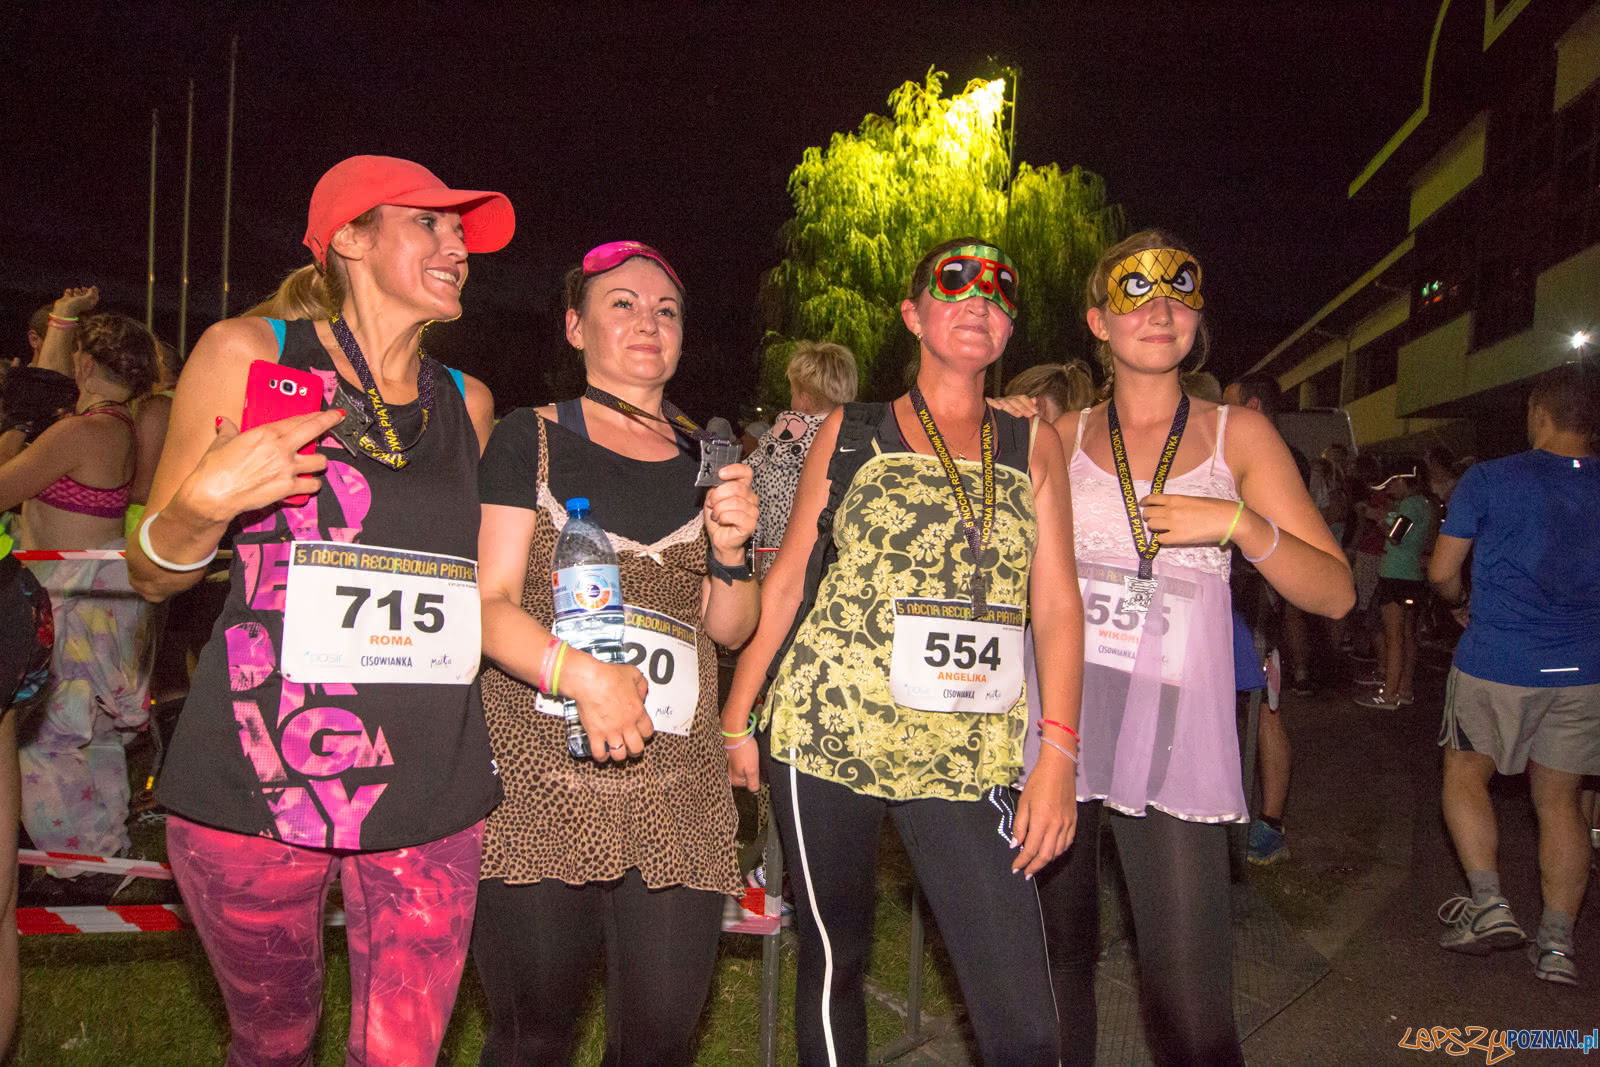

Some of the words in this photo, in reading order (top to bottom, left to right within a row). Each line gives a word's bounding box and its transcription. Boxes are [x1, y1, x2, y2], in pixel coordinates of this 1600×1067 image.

[932, 436, 961, 485] RECORDOWA
[1112, 435, 1124, 463] NOCNA
[1118, 462, 1137, 518] RECORDOWA
[982, 451, 994, 506] RECORDOWA
[954, 485, 974, 520] NOCNA
[981, 507, 994, 543] NOCNA
[296, 549, 307, 564] 5
[311, 549, 357, 567] NOCNA
[360, 554, 438, 576] RECORDOWA
[336, 585, 445, 634] 715
[624, 612, 672, 633] CORDOWA
[896, 601, 904, 614] 5
[906, 603, 940, 616] NOCNA
[369, 634, 414, 646] ROMA
[924, 632, 1002, 671] 554
[360, 655, 413, 668] CISOWIANKA
[624, 641, 675, 685] 20
[937, 671, 987, 683] ANGELIKA
[943, 688, 975, 699] CISOWIANKA
